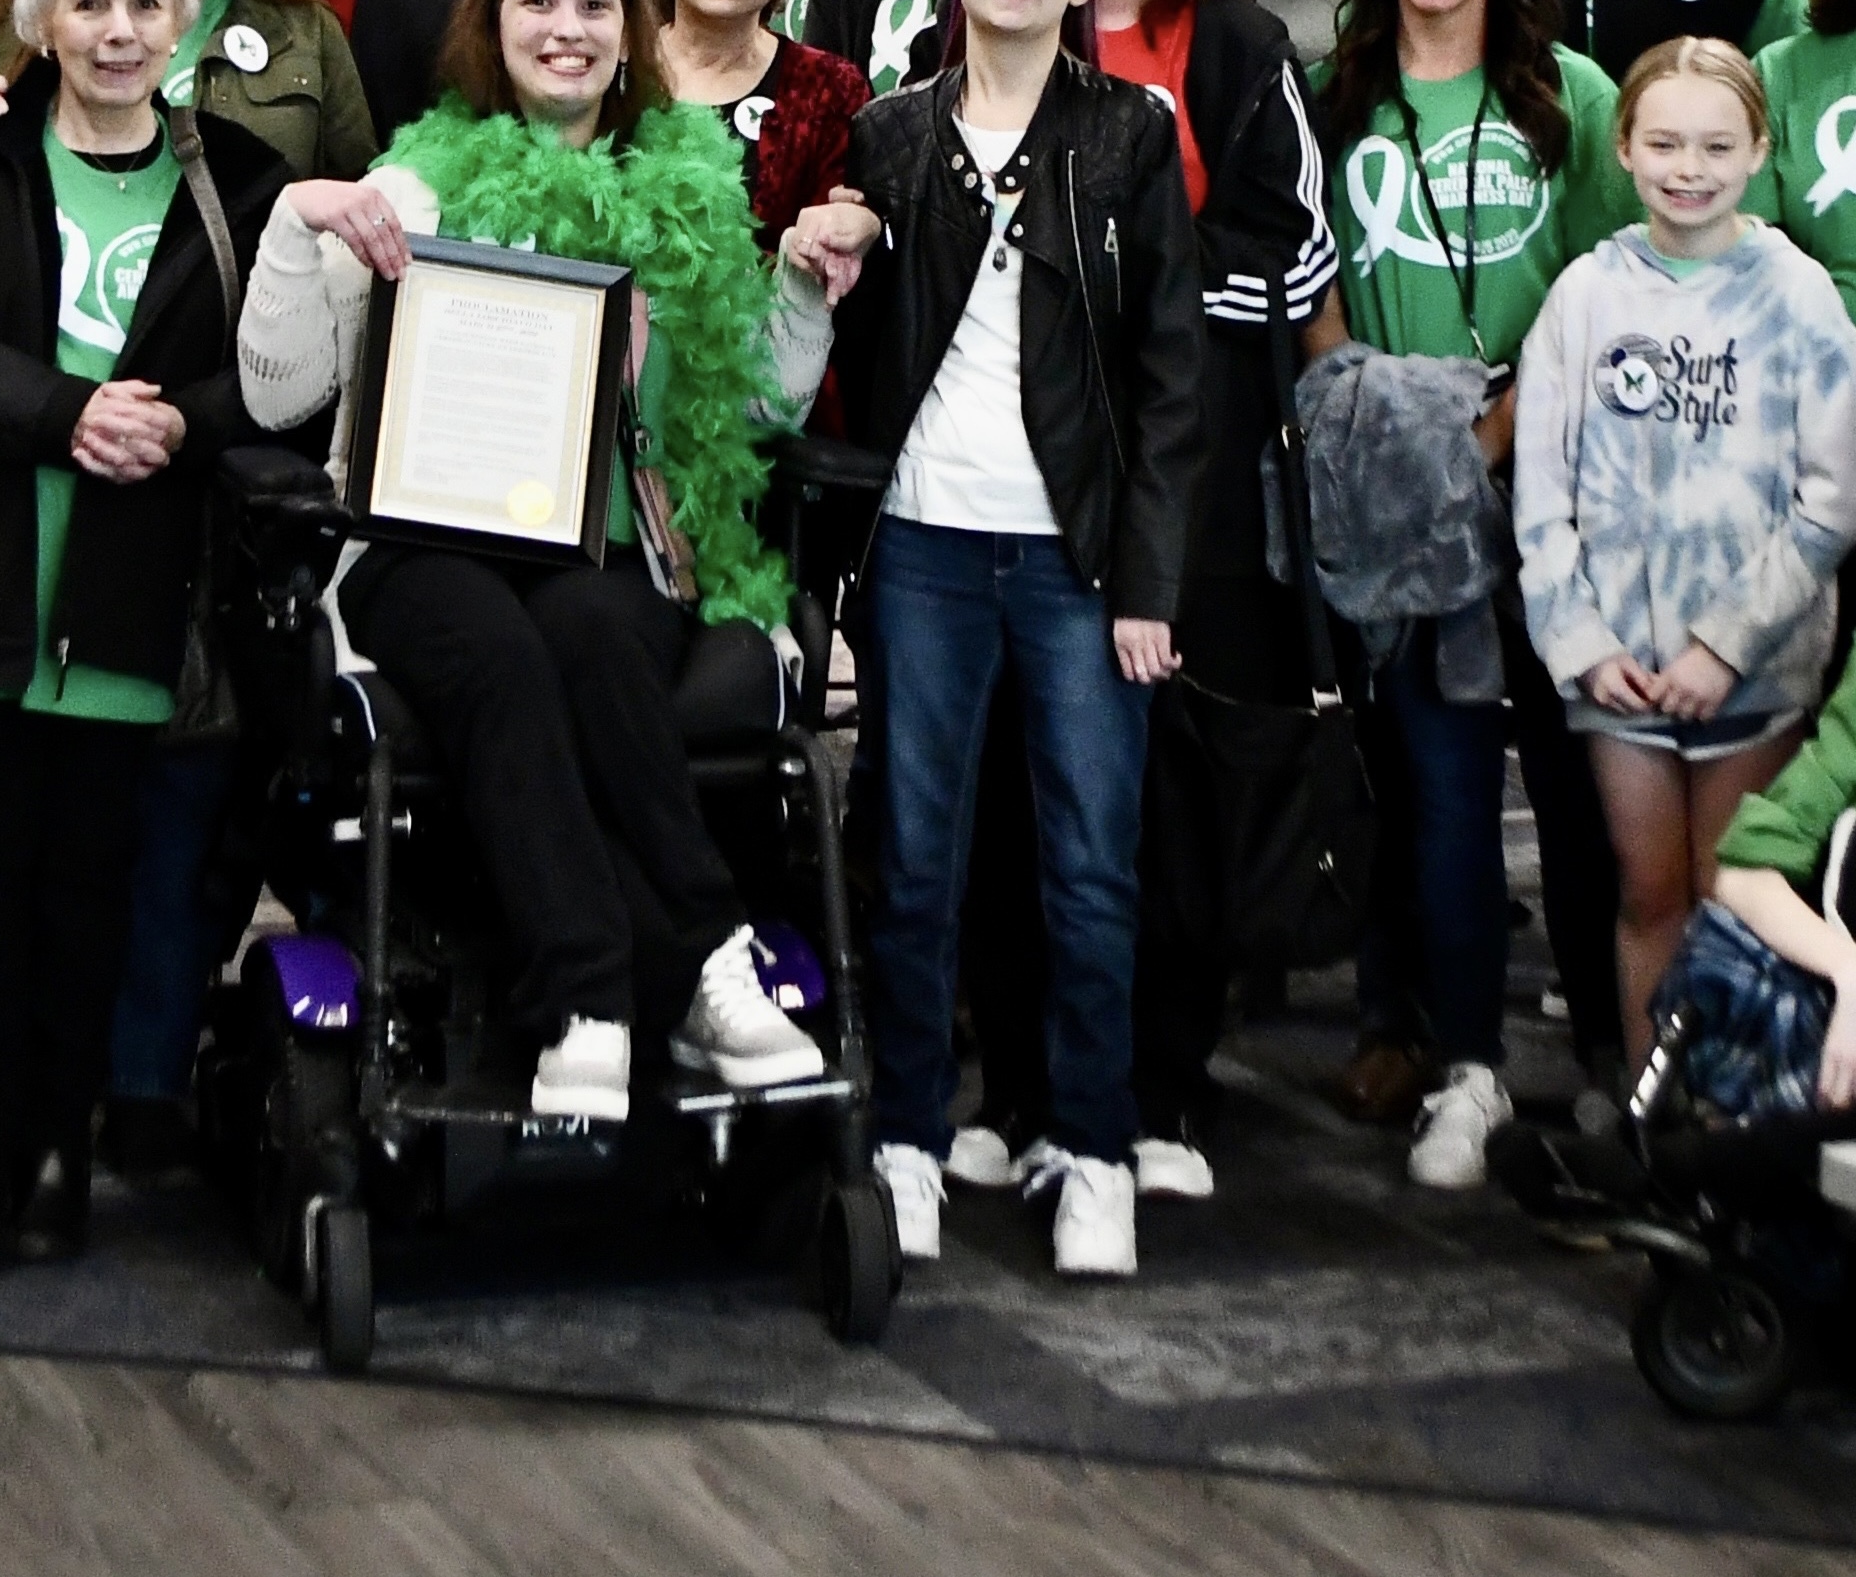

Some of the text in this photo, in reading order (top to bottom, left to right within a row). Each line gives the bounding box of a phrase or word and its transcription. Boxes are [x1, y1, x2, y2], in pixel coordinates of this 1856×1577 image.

[1448, 158, 1511, 178] NAONAL
[1427, 174, 1494, 194] CEREBAL
[1431, 190, 1506, 209] WARNESS
[1657, 334, 1738, 396] Surf
[1655, 381, 1738, 443] Style
